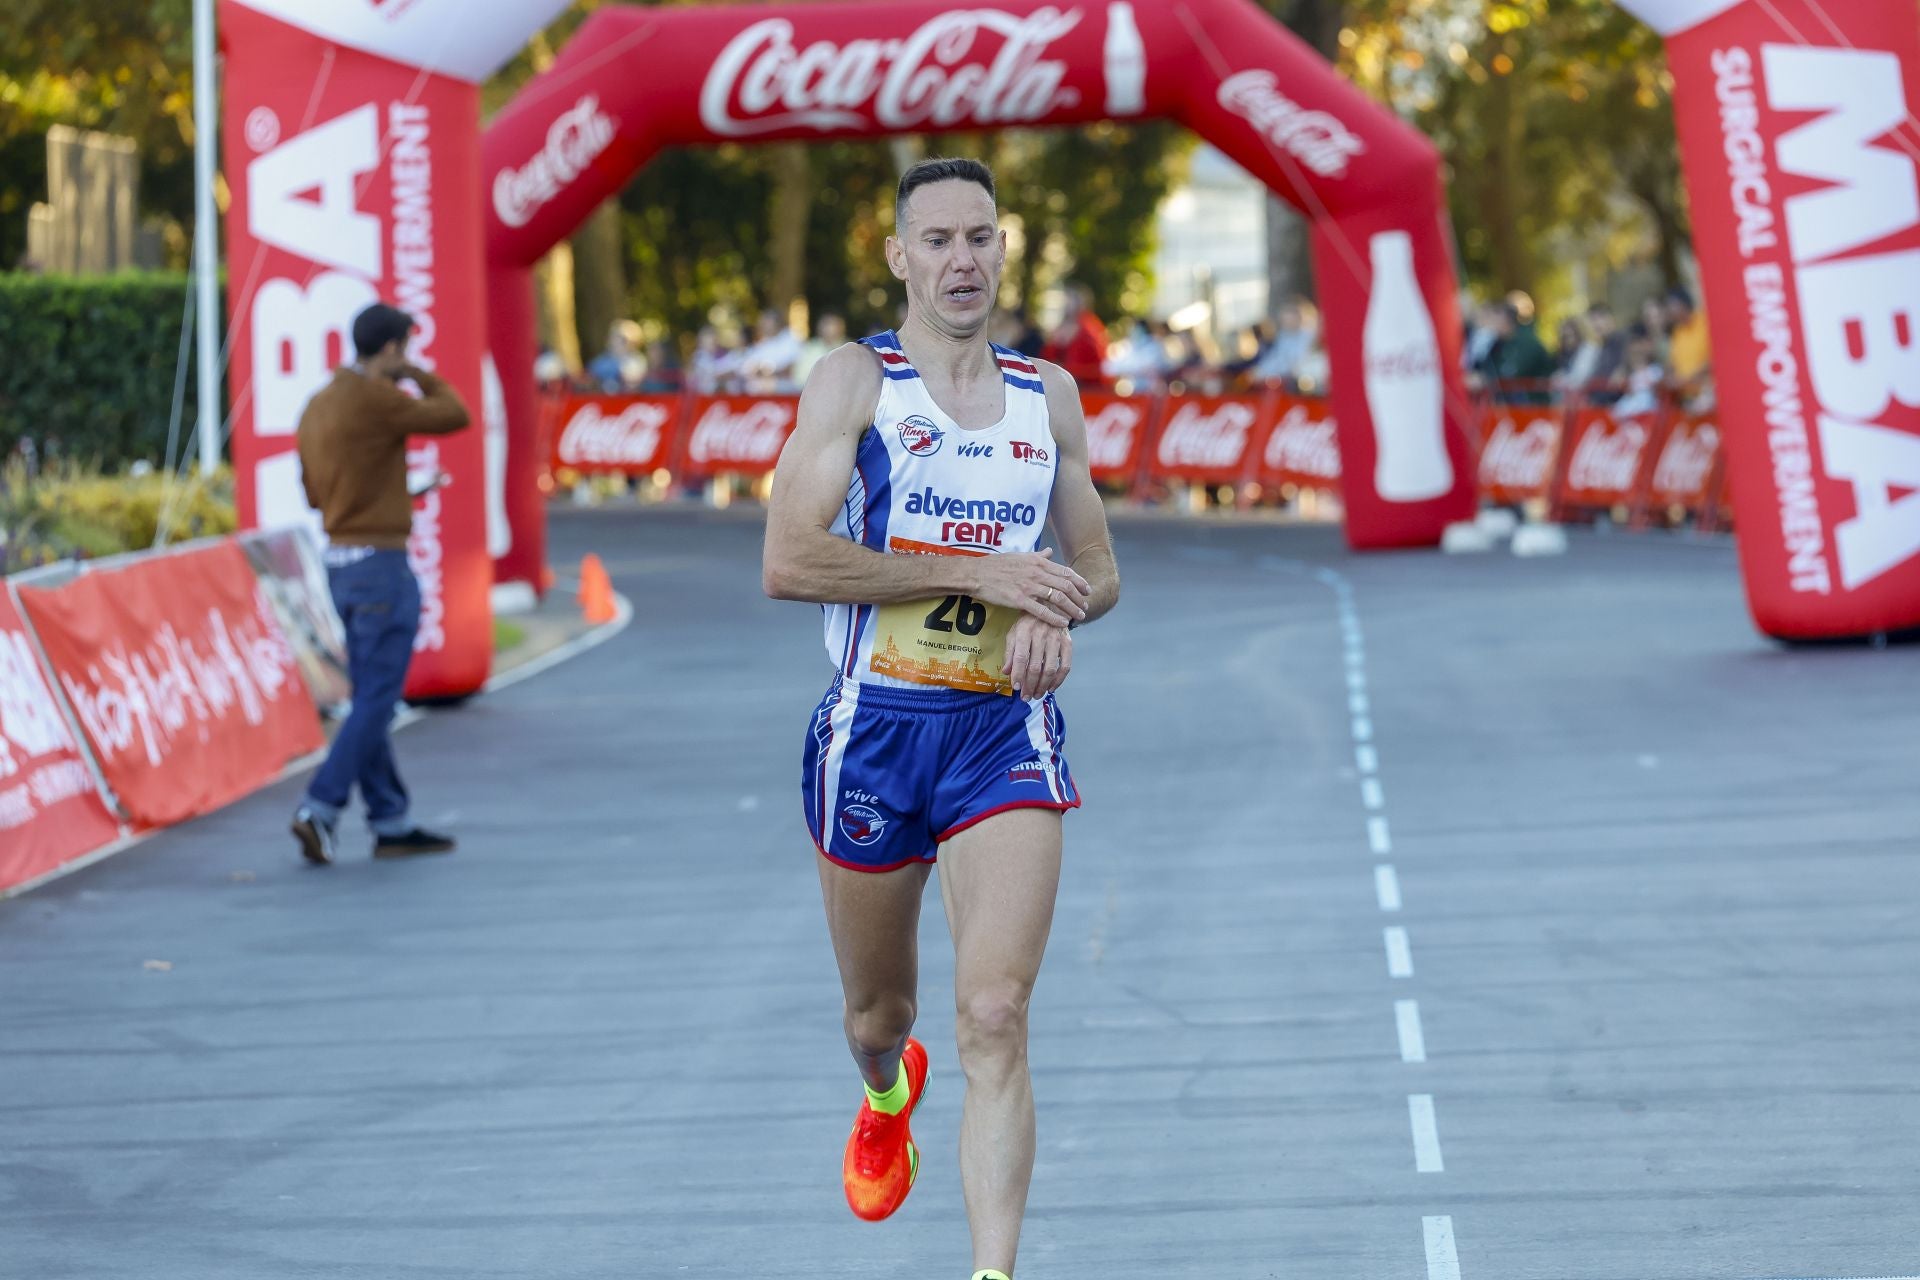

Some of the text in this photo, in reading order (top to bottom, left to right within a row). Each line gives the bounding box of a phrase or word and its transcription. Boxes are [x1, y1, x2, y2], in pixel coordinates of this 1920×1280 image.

[701, 7, 1082, 136] Coca-Cola
[1217, 68, 1364, 178] Coca-Cola
[492, 96, 616, 227] Coca-Cola
[1711, 46, 1831, 594] SURGICAL EMPOWERMENT
[1760, 42, 1920, 592] MBA
[904, 486, 1036, 526] alvemaco
[941, 522, 1004, 546] rent
[916, 638, 946, 650] MANUEL
[924, 595, 986, 636] 26
